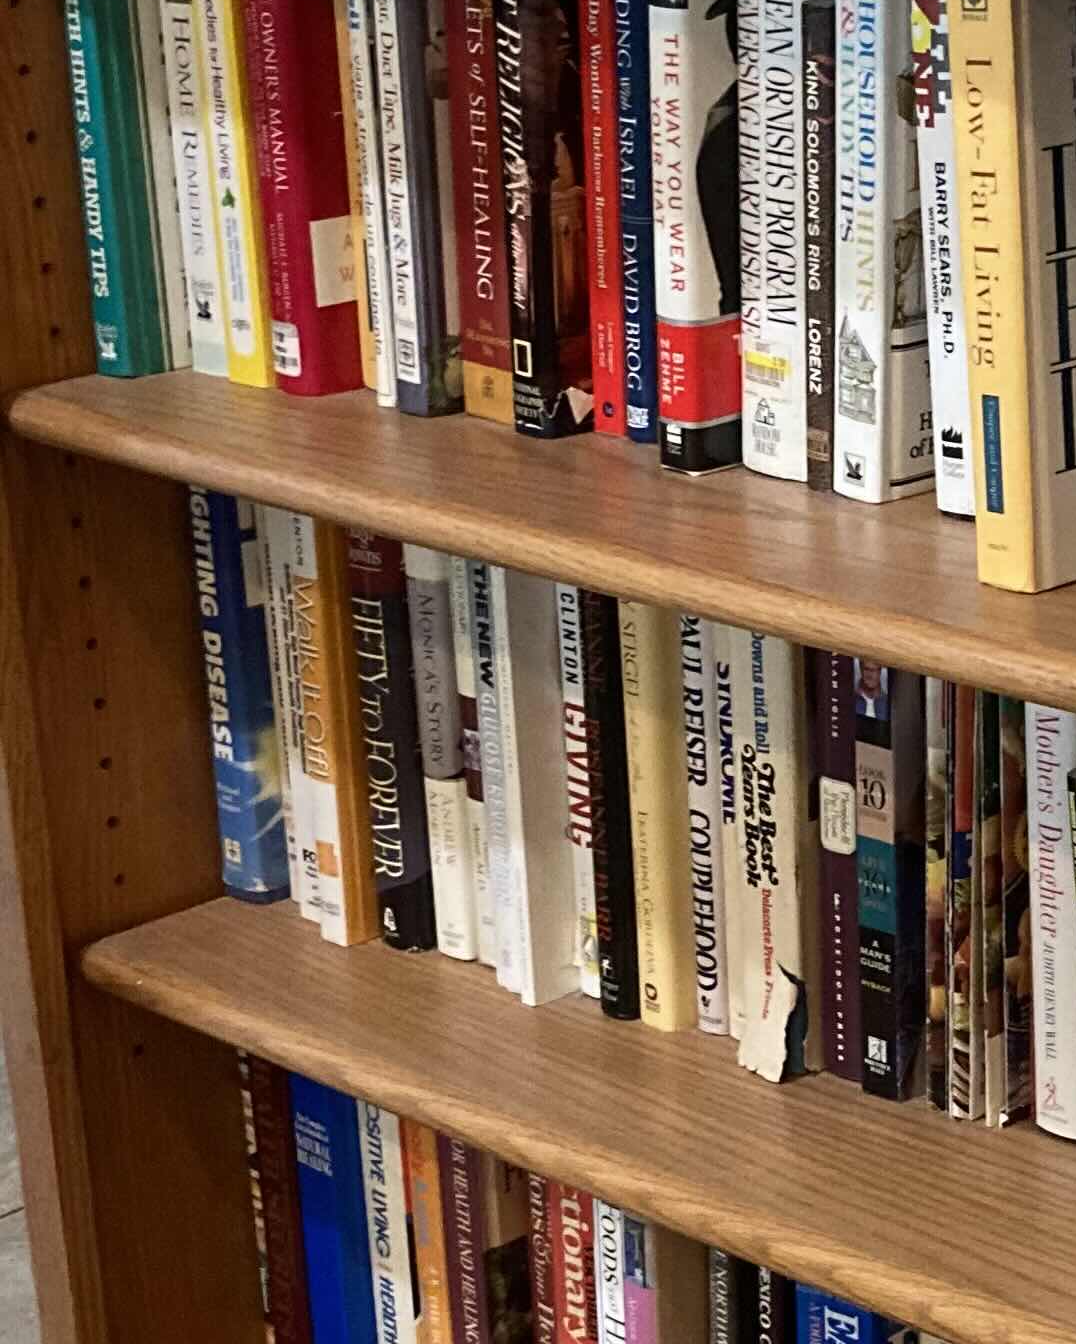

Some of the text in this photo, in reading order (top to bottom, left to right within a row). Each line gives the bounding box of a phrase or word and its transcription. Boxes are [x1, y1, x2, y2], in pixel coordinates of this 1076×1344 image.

[70, 49, 91, 123] HINTS
[380, 30, 395, 78] Duct
[471, 63, 484, 83] of
[76, 128, 95, 155] &
[379, 84, 399, 134] Tape,
[80, 158, 104, 241] HANDY
[388, 142, 402, 185] Milk
[467, 89, 495, 302] SELF-HEALING
[618, 117, 638, 201] ISRAEL
[664, 35, 686, 292] THE WAY YOU WEAR
[740, 131, 762, 223] HEART
[805, 60, 821, 292] KING SOLOMON'S RING
[934, 162, 949, 231] BARRY
[389, 186, 406, 230] Jugs
[965, 60, 1001, 370] Low-Fat Living
[90, 248, 110, 298] TIPS
[396, 258, 410, 307] More
[740, 226, 762, 343] DISEASE
[938, 234, 952, 303] SEARS,
[622, 235, 643, 391] DAVID BROG
[660, 338, 672, 404] ZEHME
[672, 352, 685, 395] BILL
[808, 318, 823, 395] LORENZ
[560, 592, 580, 685] CLINTON
[203, 631, 233, 762] DISEASE
[680, 616, 707, 787] PAUL REISER
[753, 688, 770, 754] and Roll
[564, 702, 594, 849] GIVING
[741, 744, 761, 888] Years Book
[757, 762, 780, 886] The Best
[1034, 712, 1064, 939] Mother's Daughter
[689, 809, 718, 992] COUPLEHOOD
